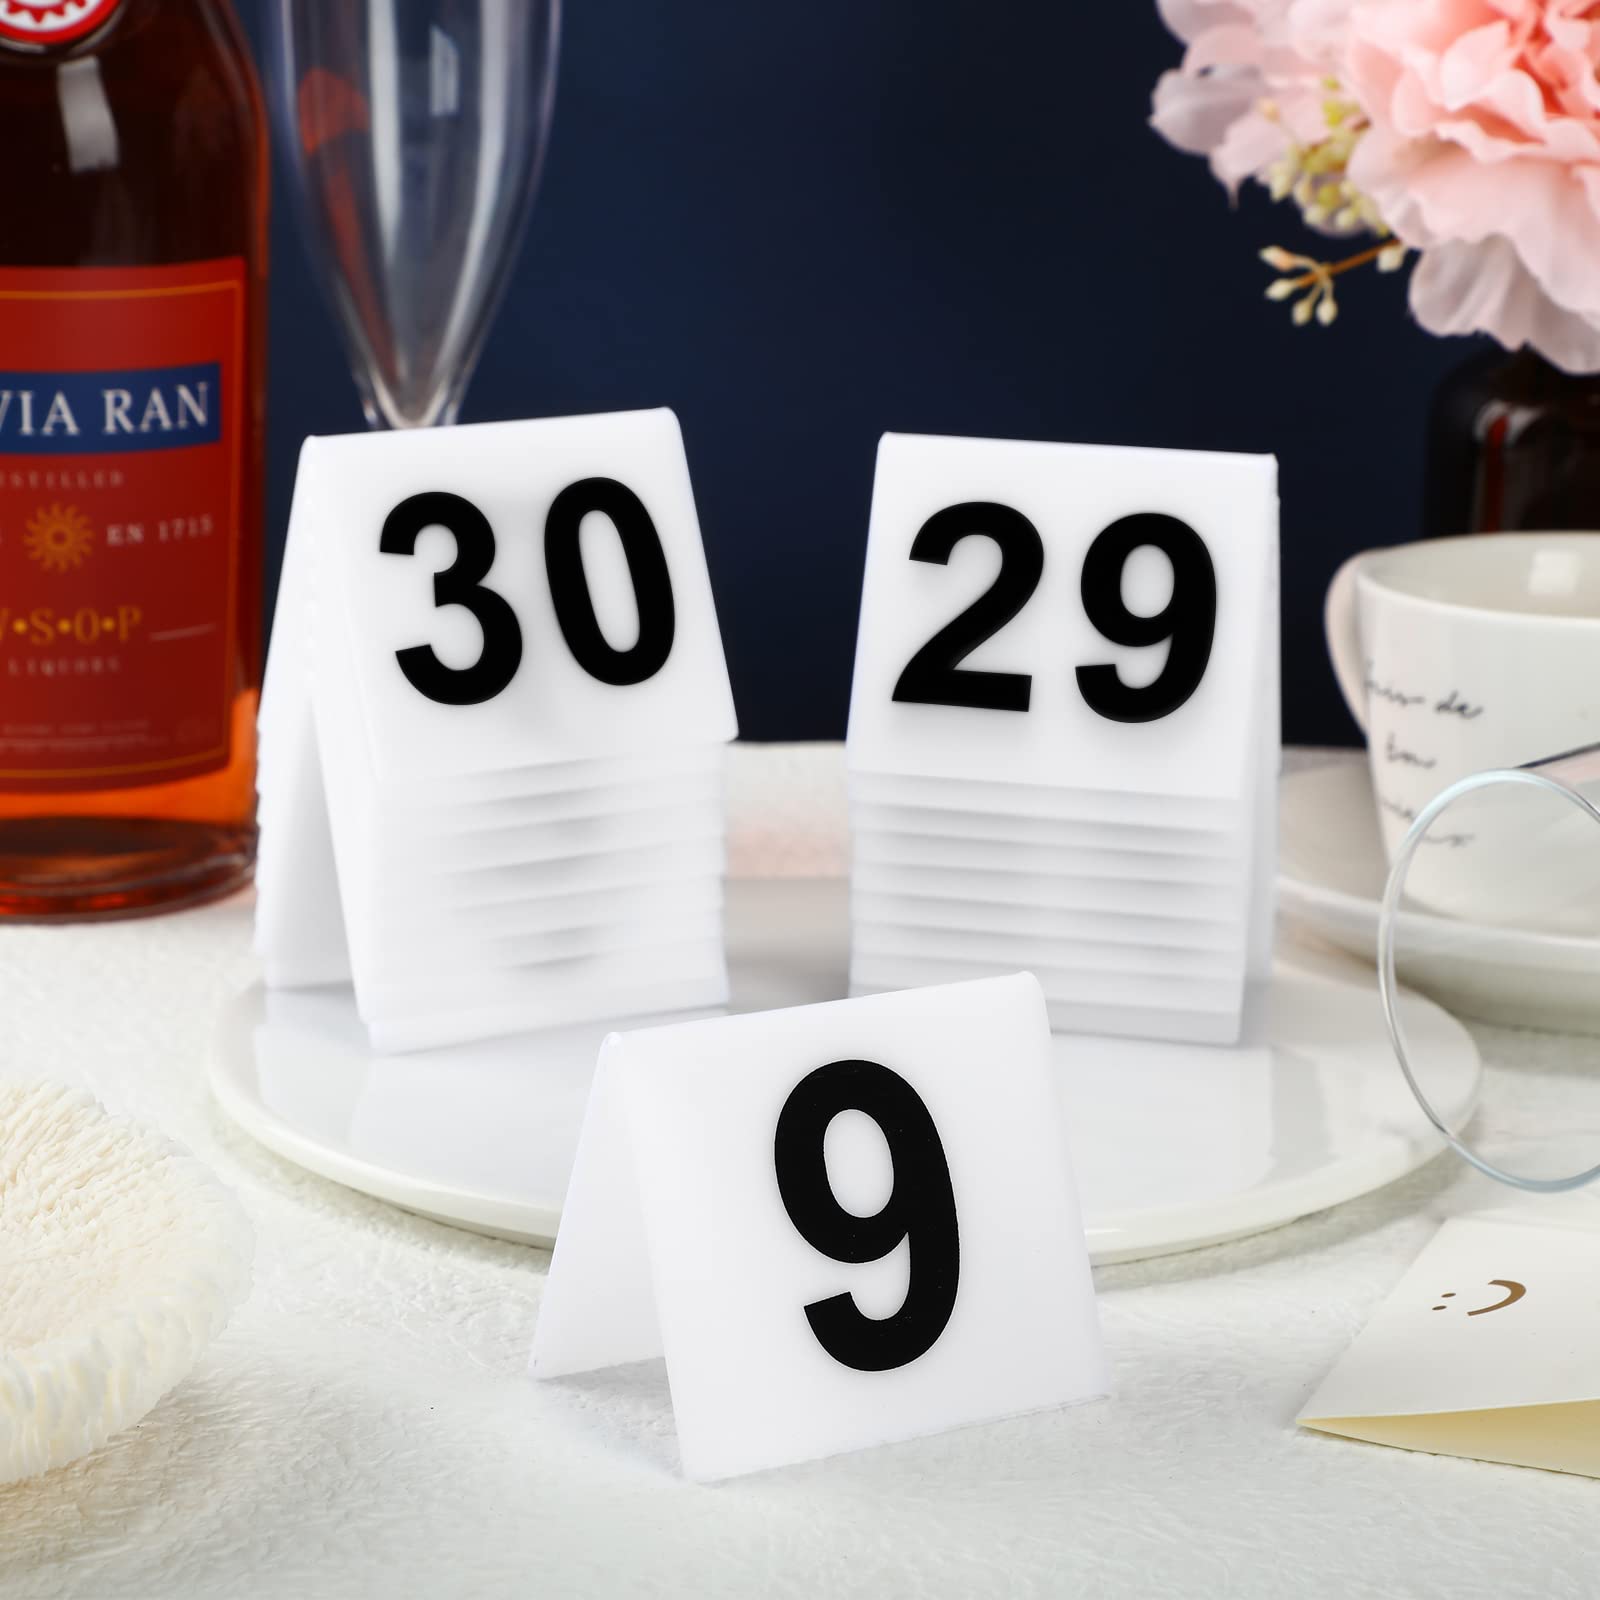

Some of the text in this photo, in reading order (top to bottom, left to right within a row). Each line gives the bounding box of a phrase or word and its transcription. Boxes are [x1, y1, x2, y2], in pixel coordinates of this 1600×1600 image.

[103, 381, 210, 434] RAN
[106, 524, 144, 546] EN
[379, 476, 676, 706] 30
[891, 501, 1217, 724] 29
[774, 1059, 961, 1372] 9
